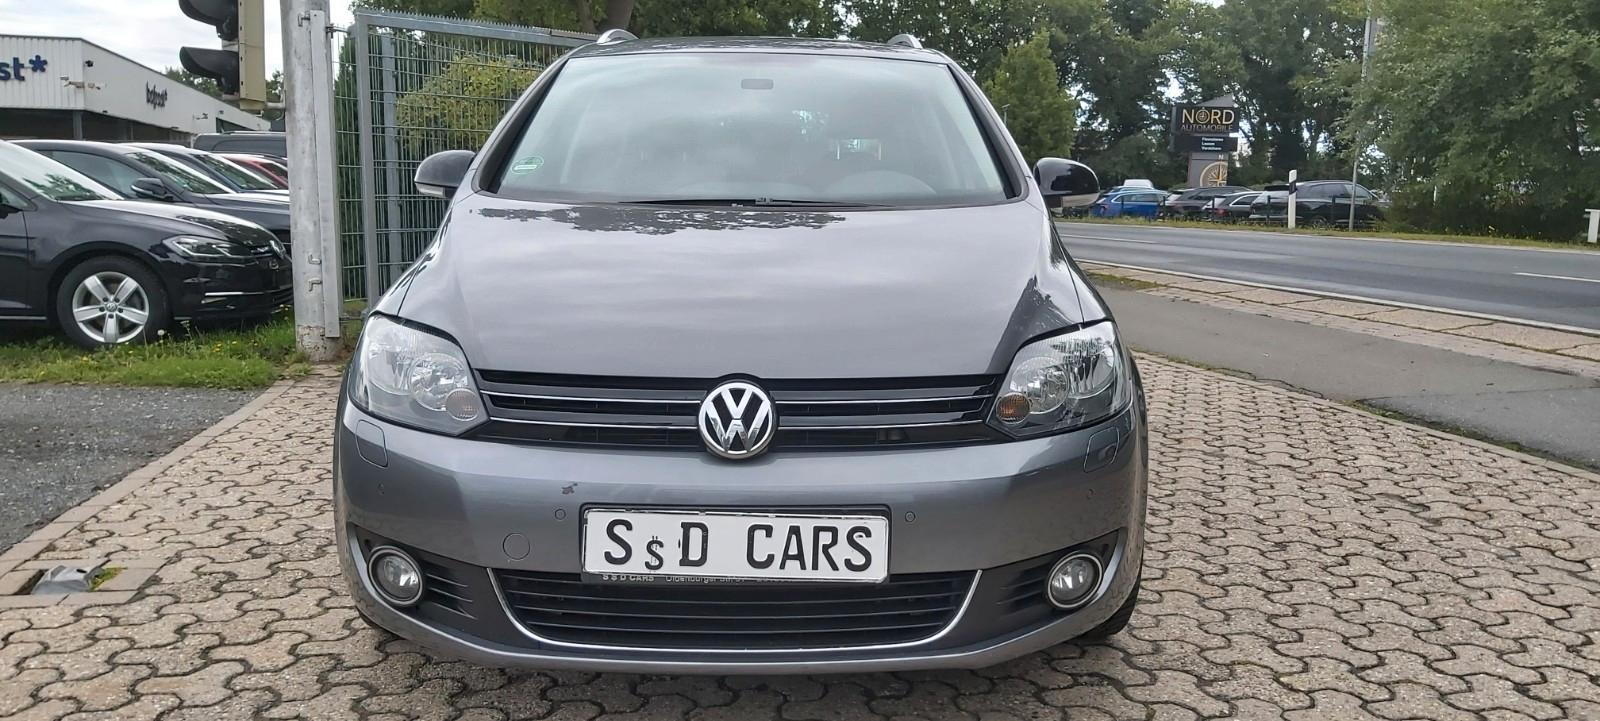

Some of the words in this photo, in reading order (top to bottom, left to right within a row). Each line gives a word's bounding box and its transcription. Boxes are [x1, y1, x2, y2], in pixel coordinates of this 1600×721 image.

[1182, 108, 1235, 124] NORD
[1180, 124, 1233, 132] AUTOMOBILE
[746, 523, 873, 573] CARS
